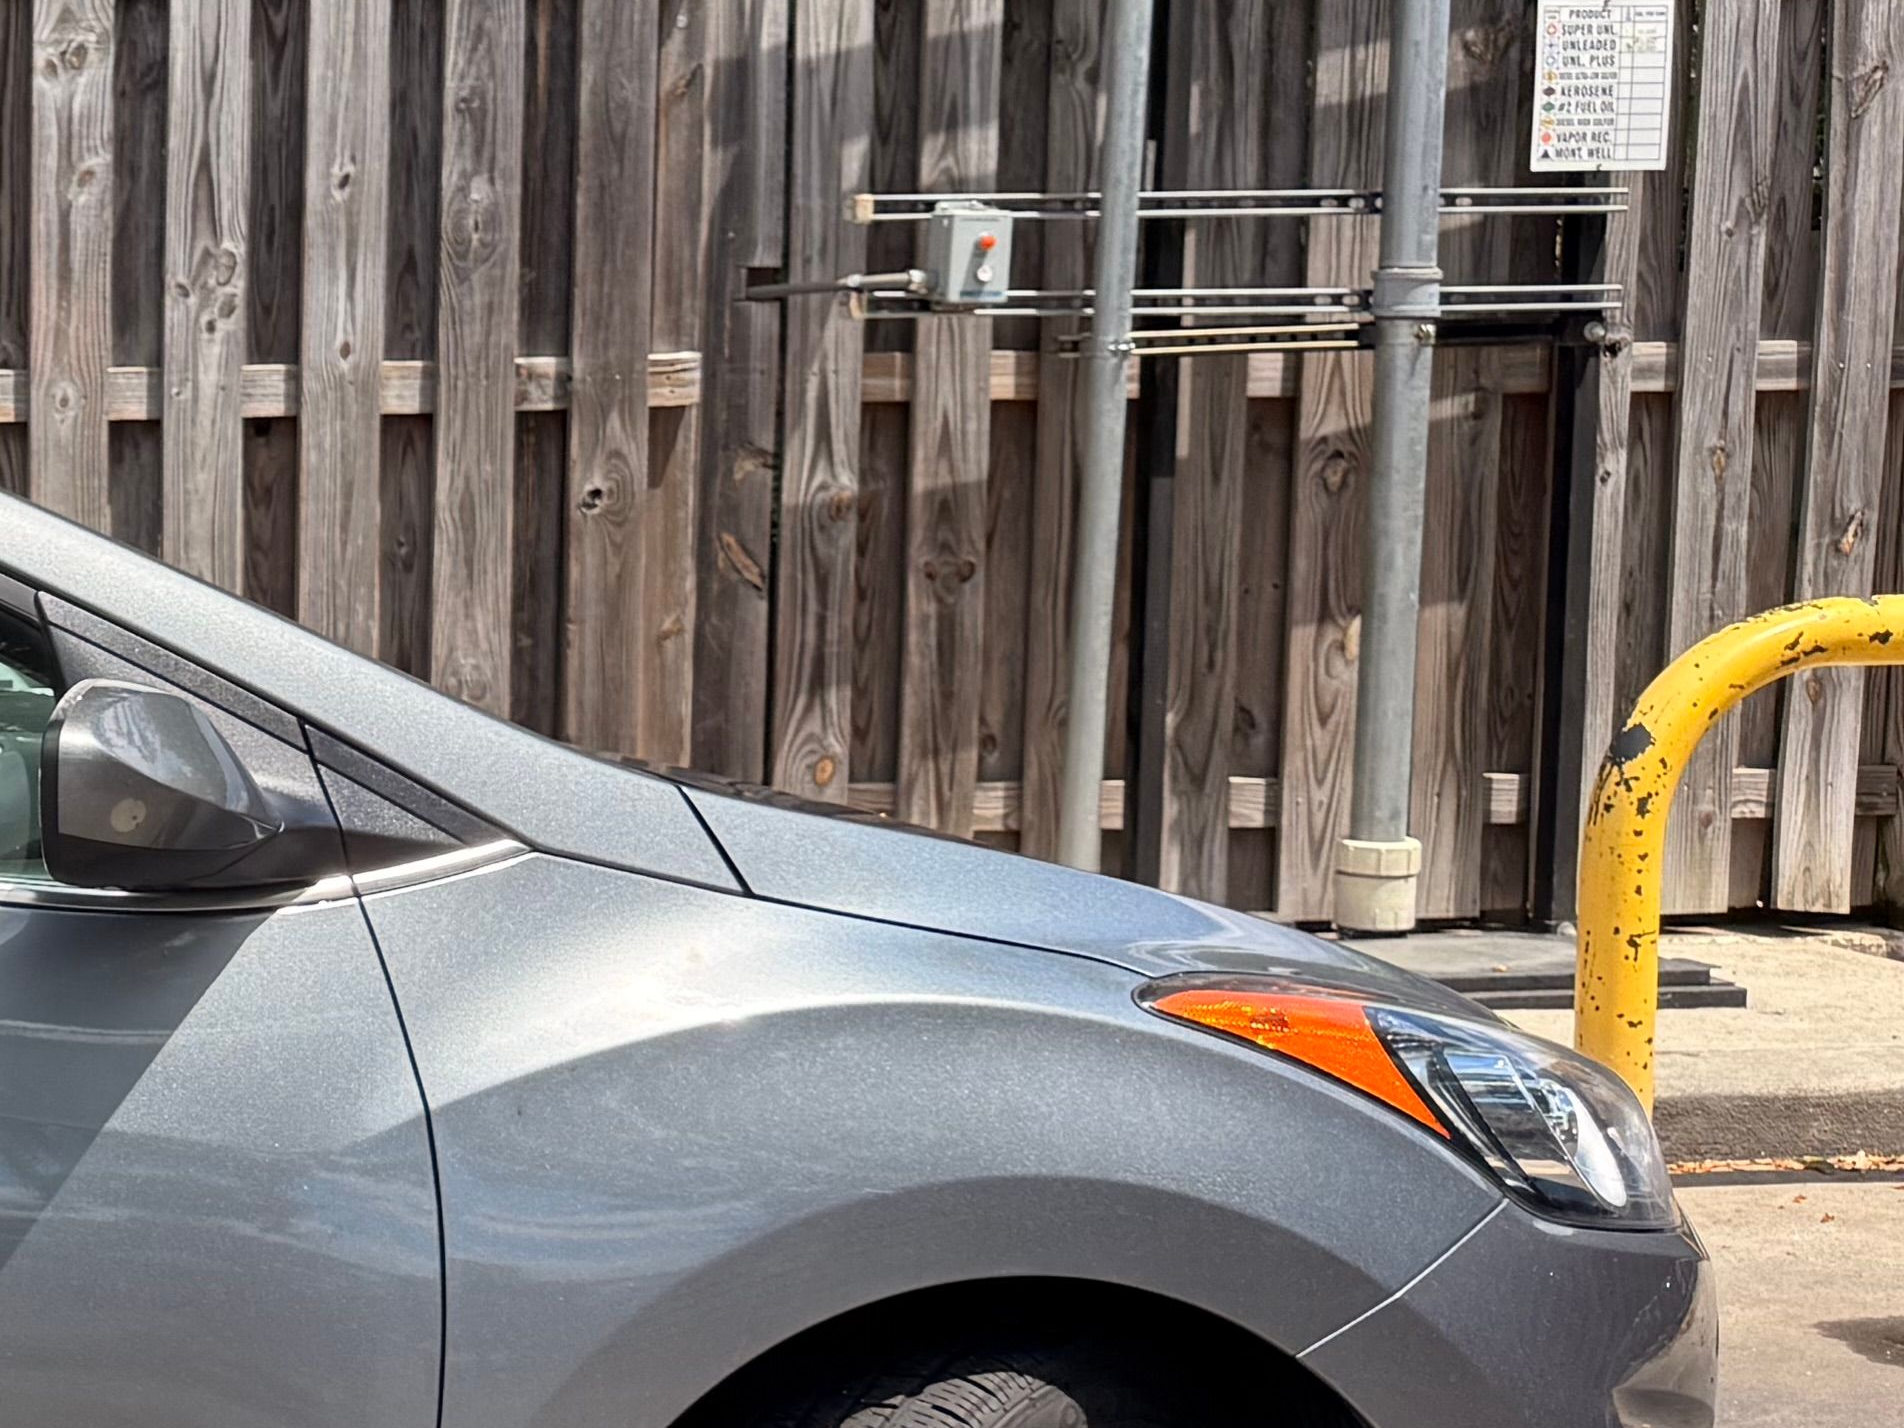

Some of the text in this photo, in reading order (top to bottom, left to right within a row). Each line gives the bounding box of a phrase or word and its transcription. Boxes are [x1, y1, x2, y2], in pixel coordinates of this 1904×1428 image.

[1569, 9, 1612, 20] PRODUCT
[1561, 24, 1593, 36] SUPER
[1562, 39, 1617, 51] UNLEADED
[1589, 55, 1616, 67] PLUS
[1575, 101, 1597, 113] FUEL
[1600, 101, 1615, 113] OIL
[1557, 132, 1588, 143] VAPOR
[1587, 147, 1611, 159] WELL
